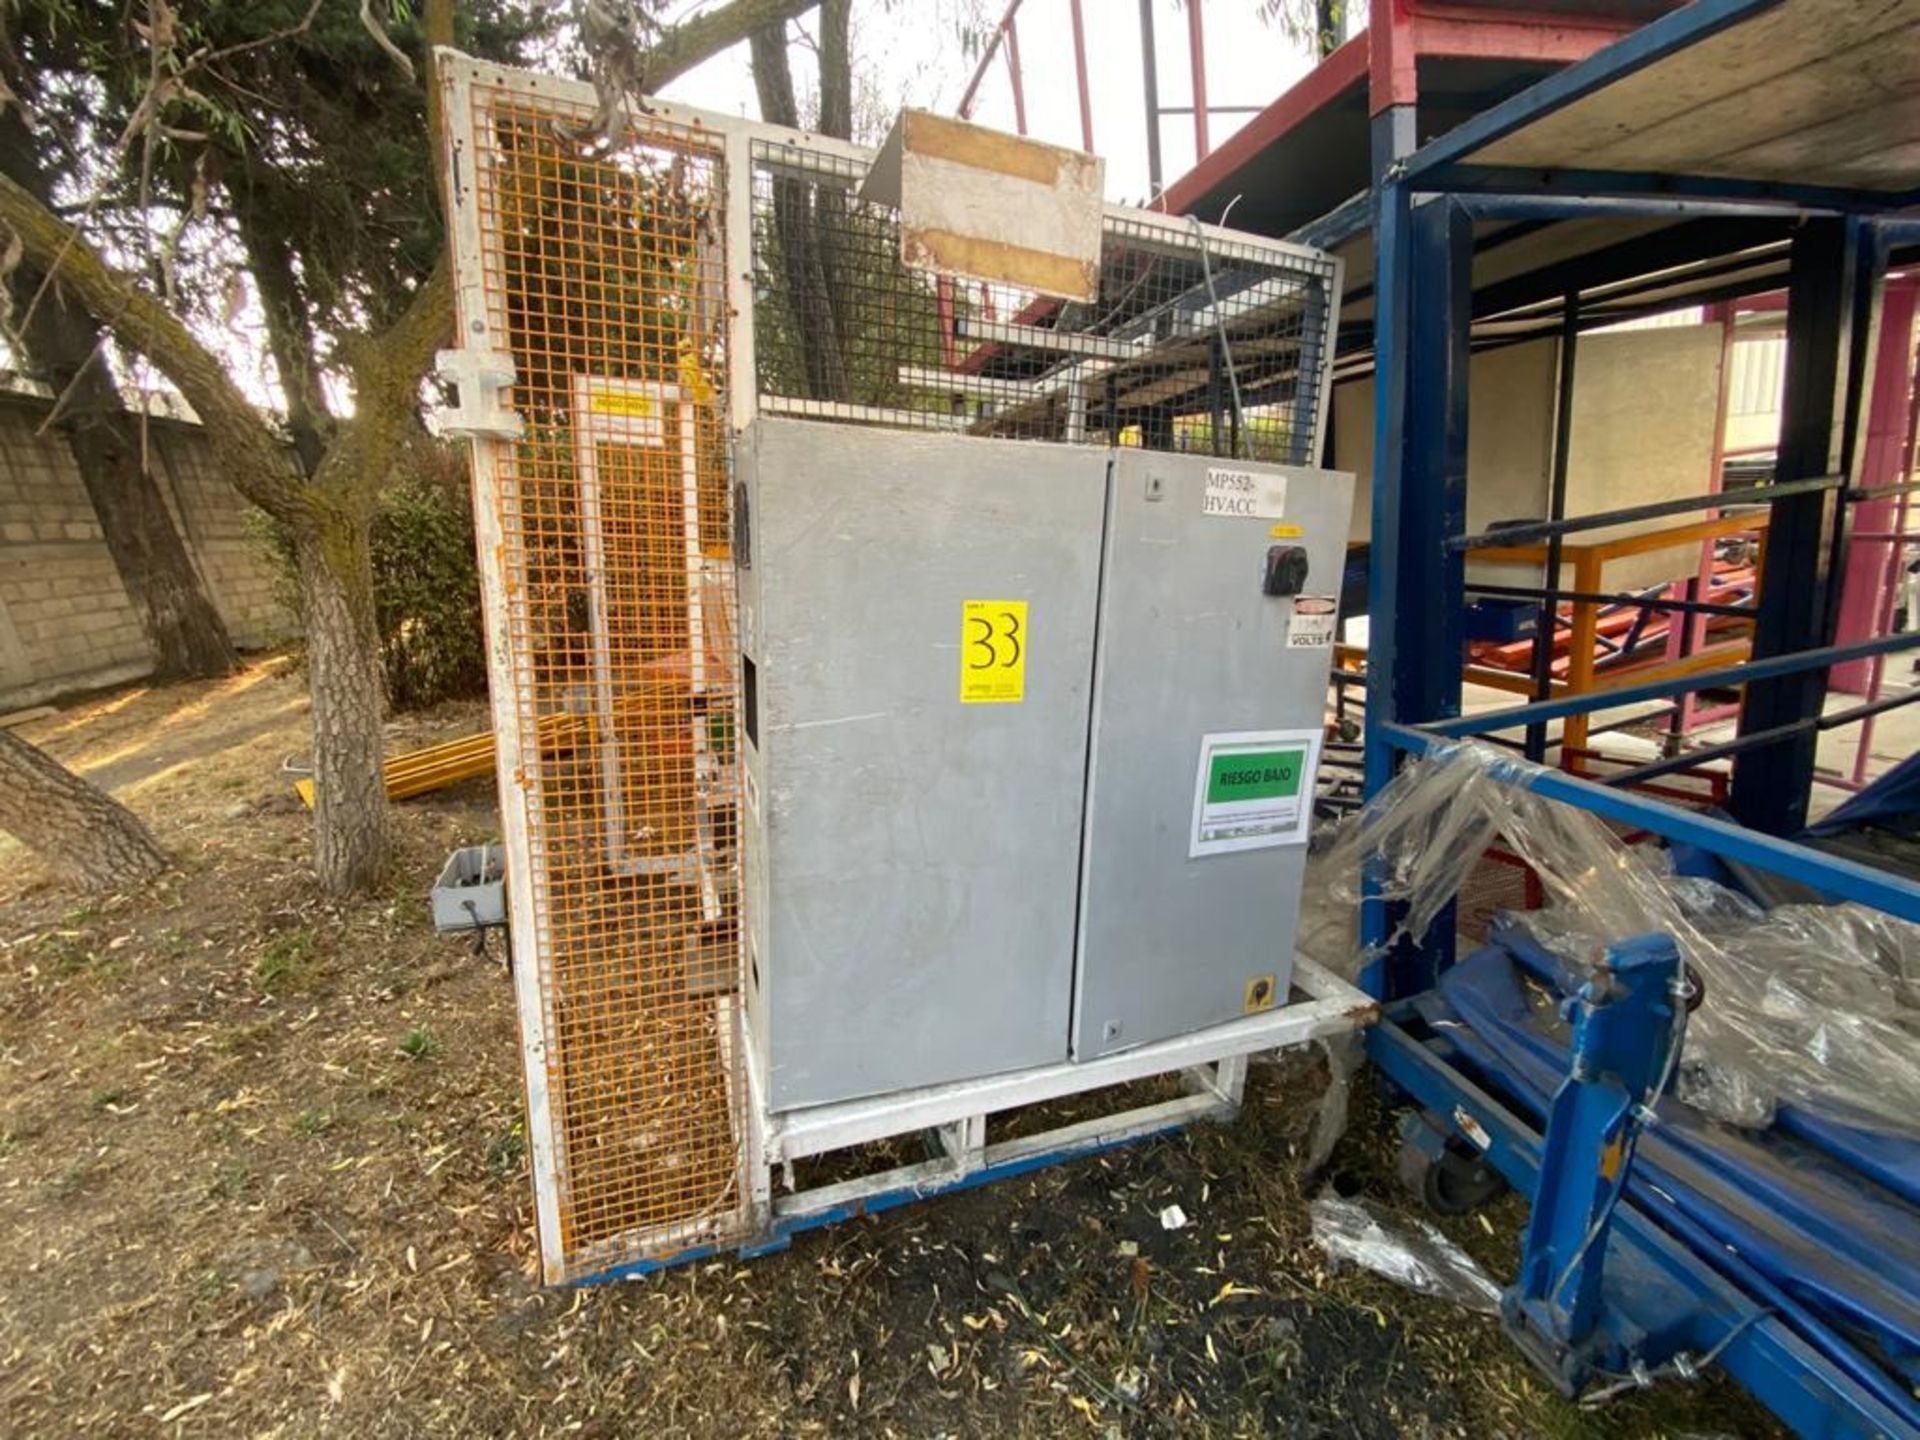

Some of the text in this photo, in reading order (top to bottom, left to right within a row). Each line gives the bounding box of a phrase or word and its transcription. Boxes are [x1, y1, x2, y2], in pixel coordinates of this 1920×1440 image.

[968, 612, 1020, 669] 33
[1291, 635, 1324, 645] VOLTS
[1220, 770, 1261, 786] RIESGO
